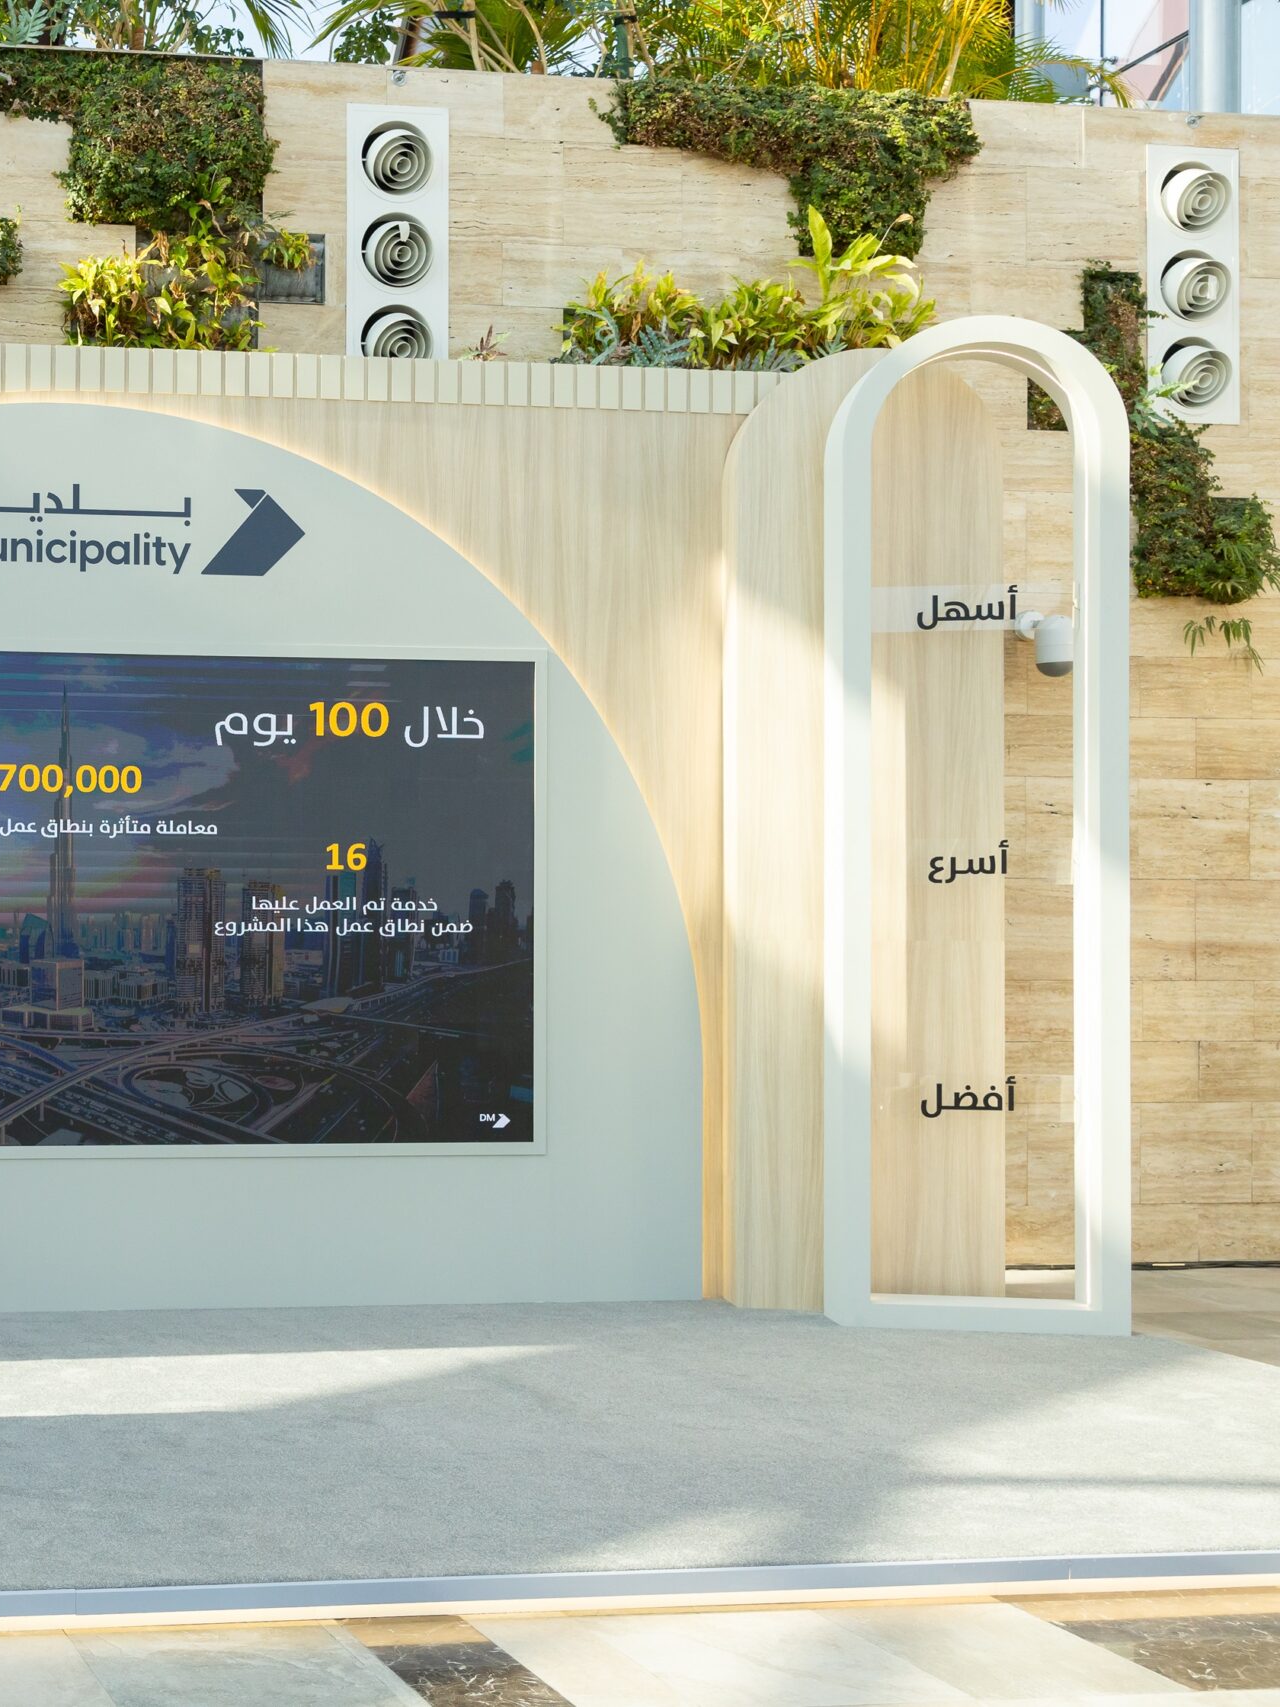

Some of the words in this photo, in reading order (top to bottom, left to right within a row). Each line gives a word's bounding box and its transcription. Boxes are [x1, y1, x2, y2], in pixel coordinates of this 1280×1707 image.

[916, 584, 1018, 631] أسهل
[309, 701, 390, 738] 100
[404, 706, 485, 748] خلال
[214, 712, 297, 747] يوم
[0, 818, 37, 837] عمل
[40, 819, 93, 838] بنطاق
[99, 815, 151, 839] متأثرة
[155, 819, 218, 836] معاملة
[325, 843, 368, 872] 16
[927, 839, 1010, 885] أسرع
[252, 896, 300, 914] عليها
[305, 896, 357, 914] العمل
[362, 898, 386, 915] تم
[391, 898, 438, 911] خدمة
[214, 916, 291, 936] المشروع
[297, 918, 329, 932] هذا
[336, 918, 374, 936] عمل
[379, 918, 425, 937] نطاق
[431, 919, 473, 937] ضمن
[920, 1076, 1017, 1119] أفضل
[479, 1113, 496, 1122] DM
